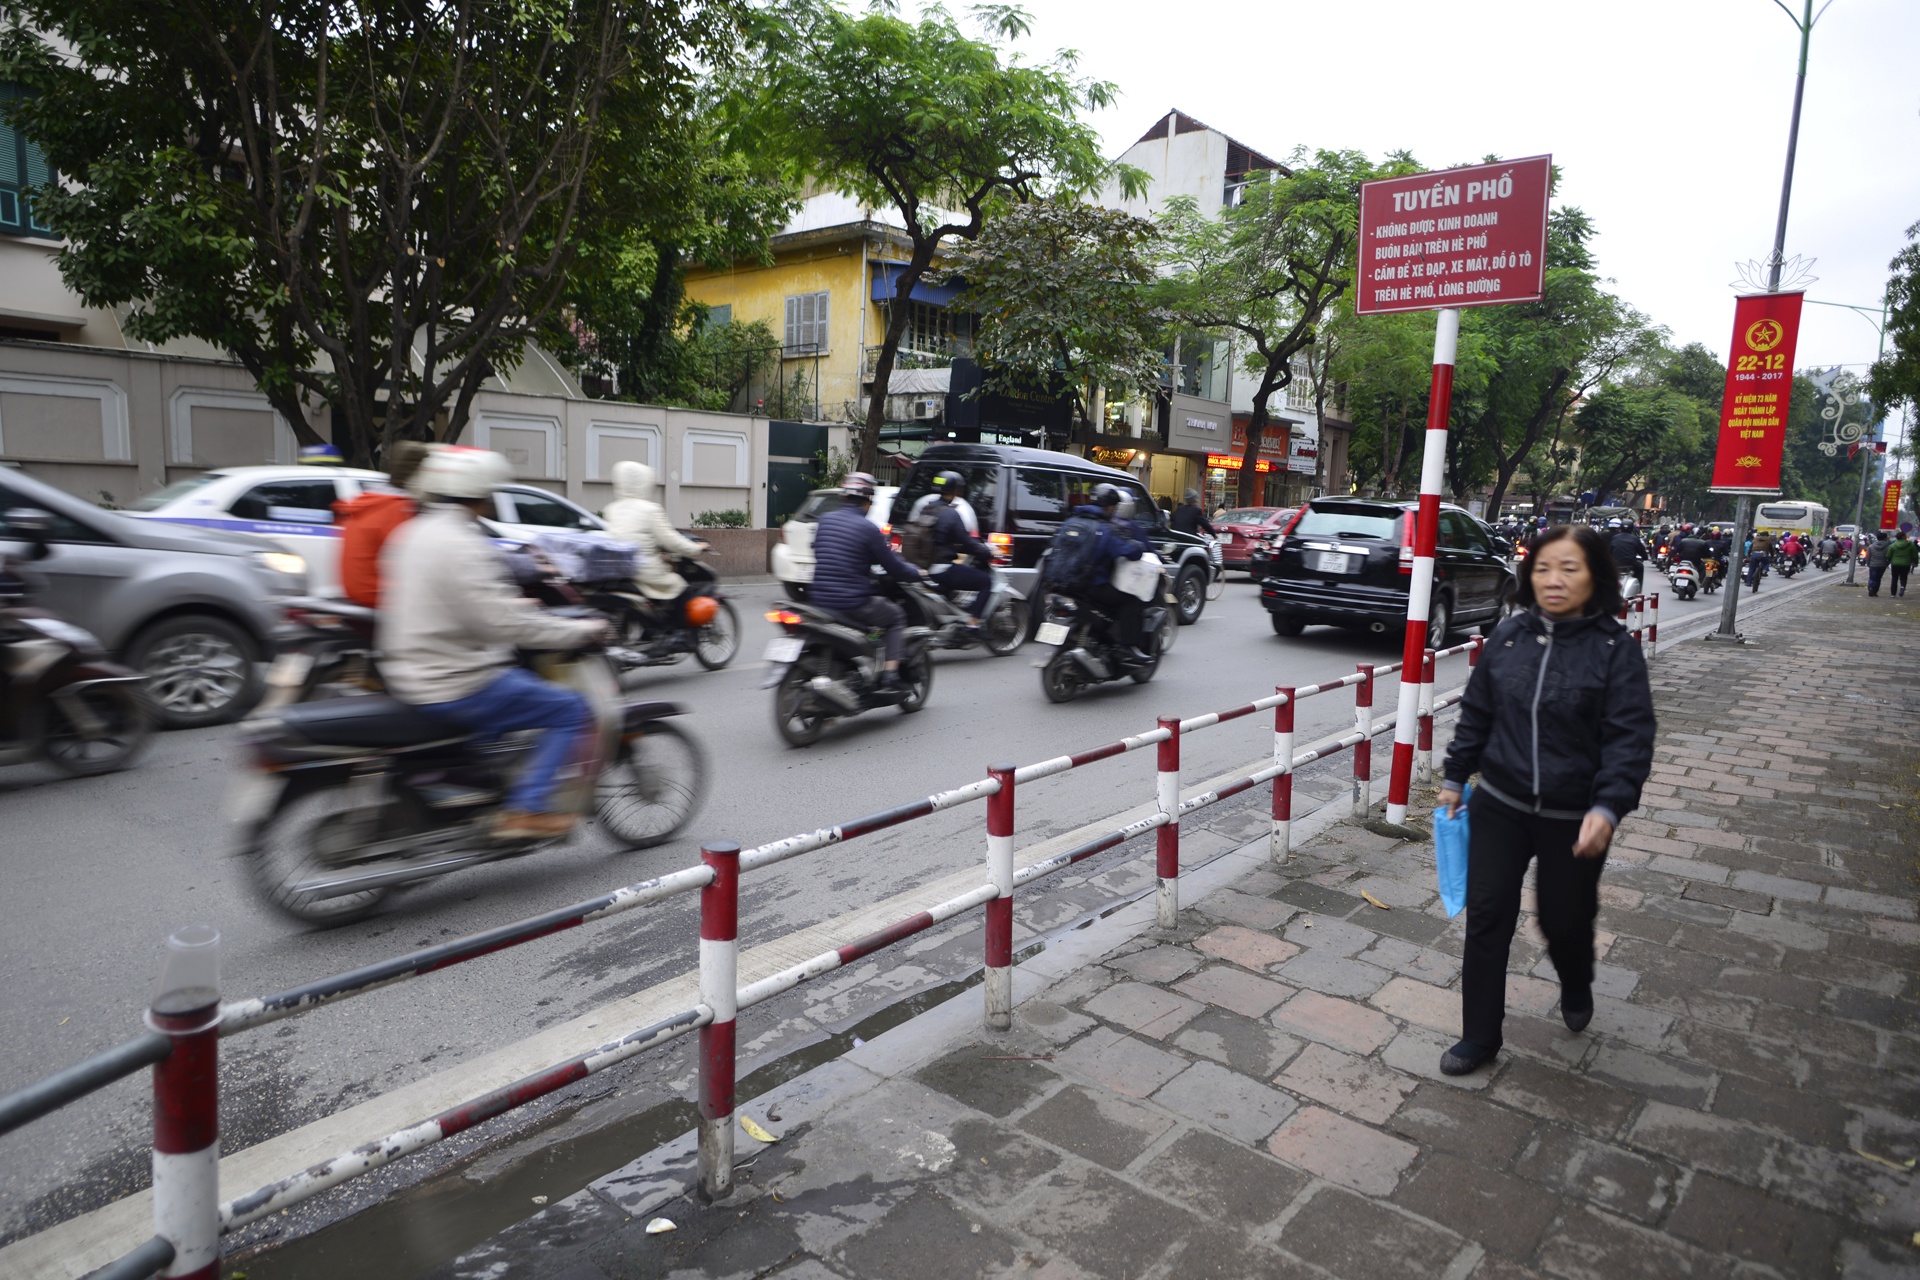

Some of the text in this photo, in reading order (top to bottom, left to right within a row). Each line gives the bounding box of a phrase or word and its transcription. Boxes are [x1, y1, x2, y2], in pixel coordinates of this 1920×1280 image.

[1393, 169, 1513, 212] TUYẾN PHỐ
[1376, 222, 1407, 239] KHÔNG
[1410, 219, 1435, 236] ĐƯỢC
[1437, 216, 1461, 231] KINH
[1463, 211, 1498, 228] DOANH
[1375, 230, 1487, 260] BUÔN BÁN TRÊN HÈ PHỐ
[1374, 263, 1395, 281] CẤM
[1397, 260, 1411, 279] ĐỂ
[1412, 264, 1424, 277] XE
[1426, 262, 1448, 278] ĐẠP,
[1451, 260, 1464, 274] XE
[1466, 255, 1491, 272] MÁY,
[1508, 251, 1517, 268] Ô
[1519, 250, 1532, 267] TÔ
[1375, 277, 1500, 302] TRÊN HÈ PHỐ, LÒNG ĐƯỜNG
[1736, 353, 1785, 371] 22-12
[1735, 373, 1755, 381] 1944
[1761, 372, 1783, 380] 2017
[1000, 386, 1029, 400] Lodon
[1757, 394, 1764, 403] 73
[998, 434, 1022, 445] England
[1752, 430, 1764, 438] NAM
